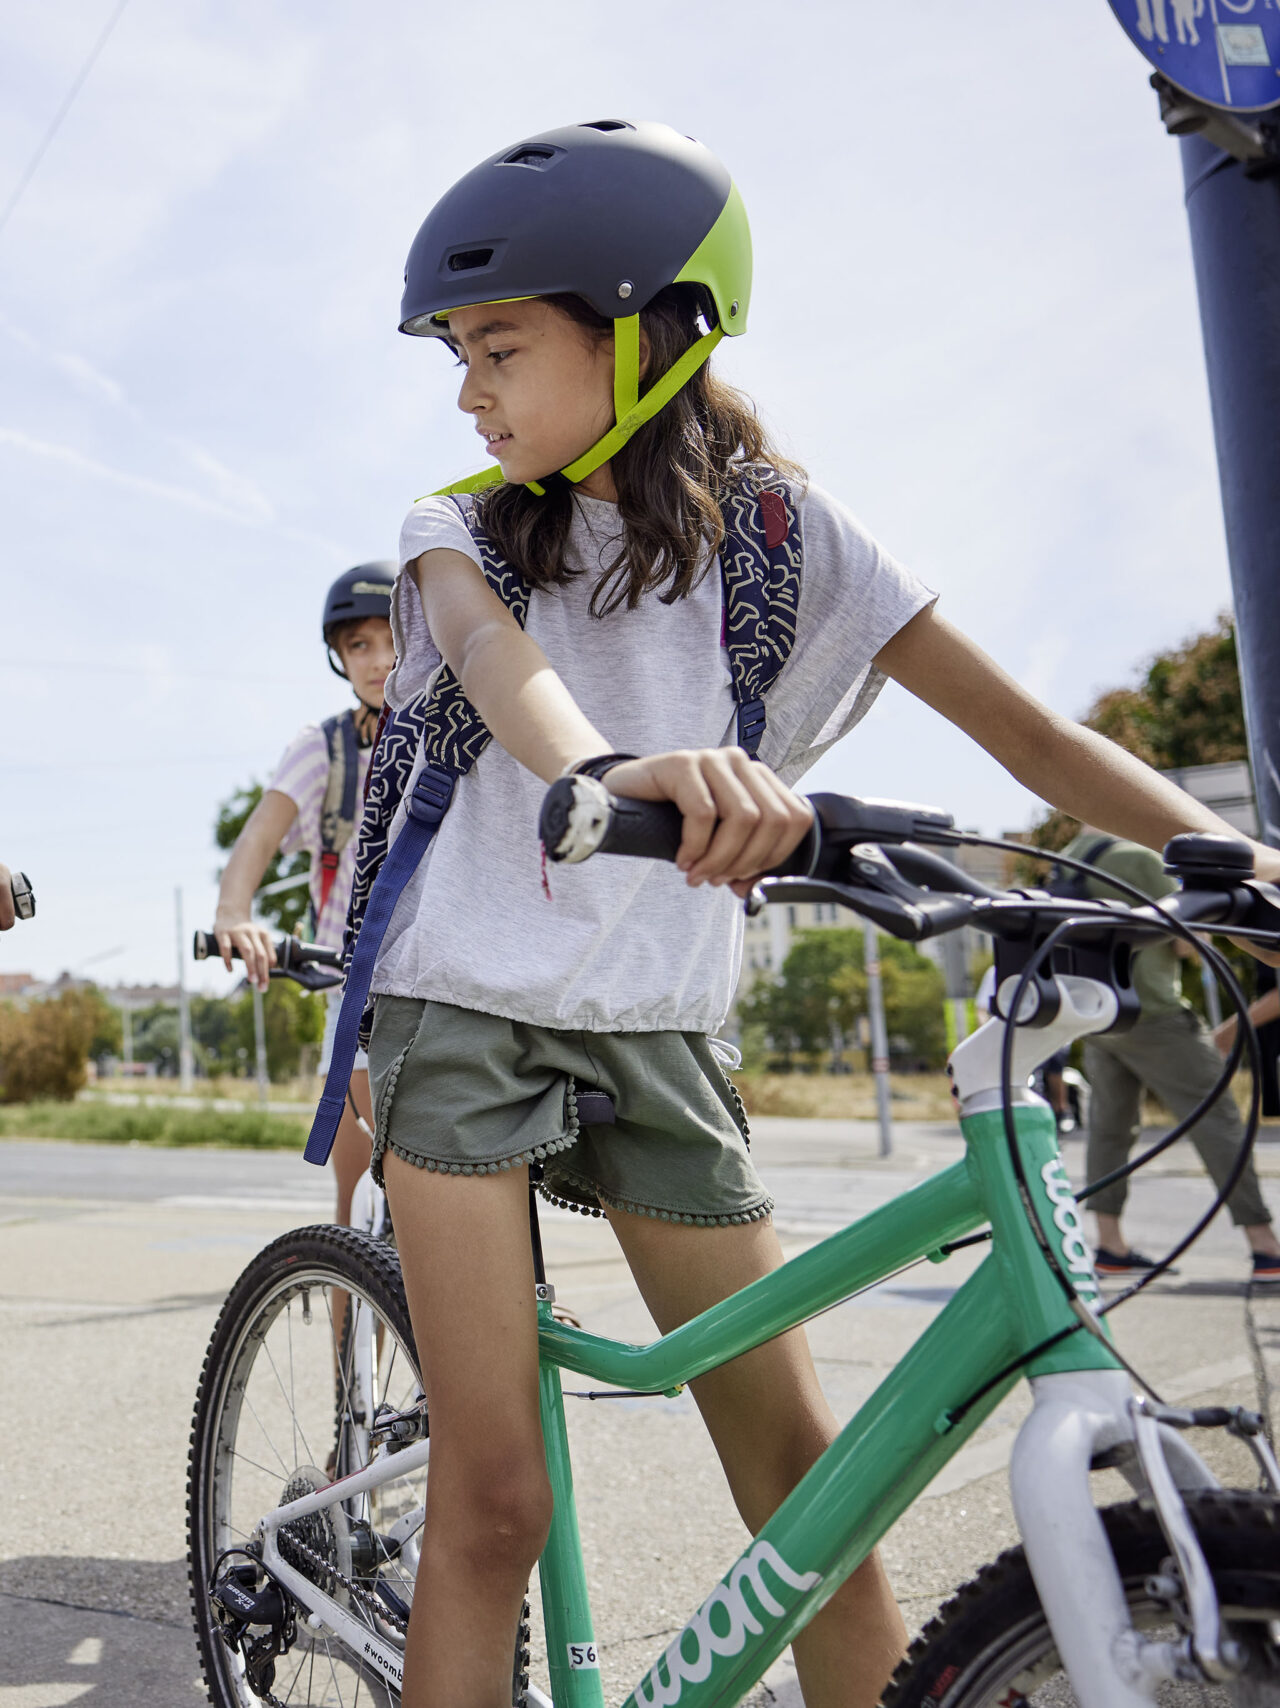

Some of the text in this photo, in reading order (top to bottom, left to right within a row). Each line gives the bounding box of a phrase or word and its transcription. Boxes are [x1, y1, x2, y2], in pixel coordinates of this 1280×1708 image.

[1041, 1152, 1104, 1317] woom
[570, 1646, 596, 1665] 56
[633, 1539, 823, 1708] woom
